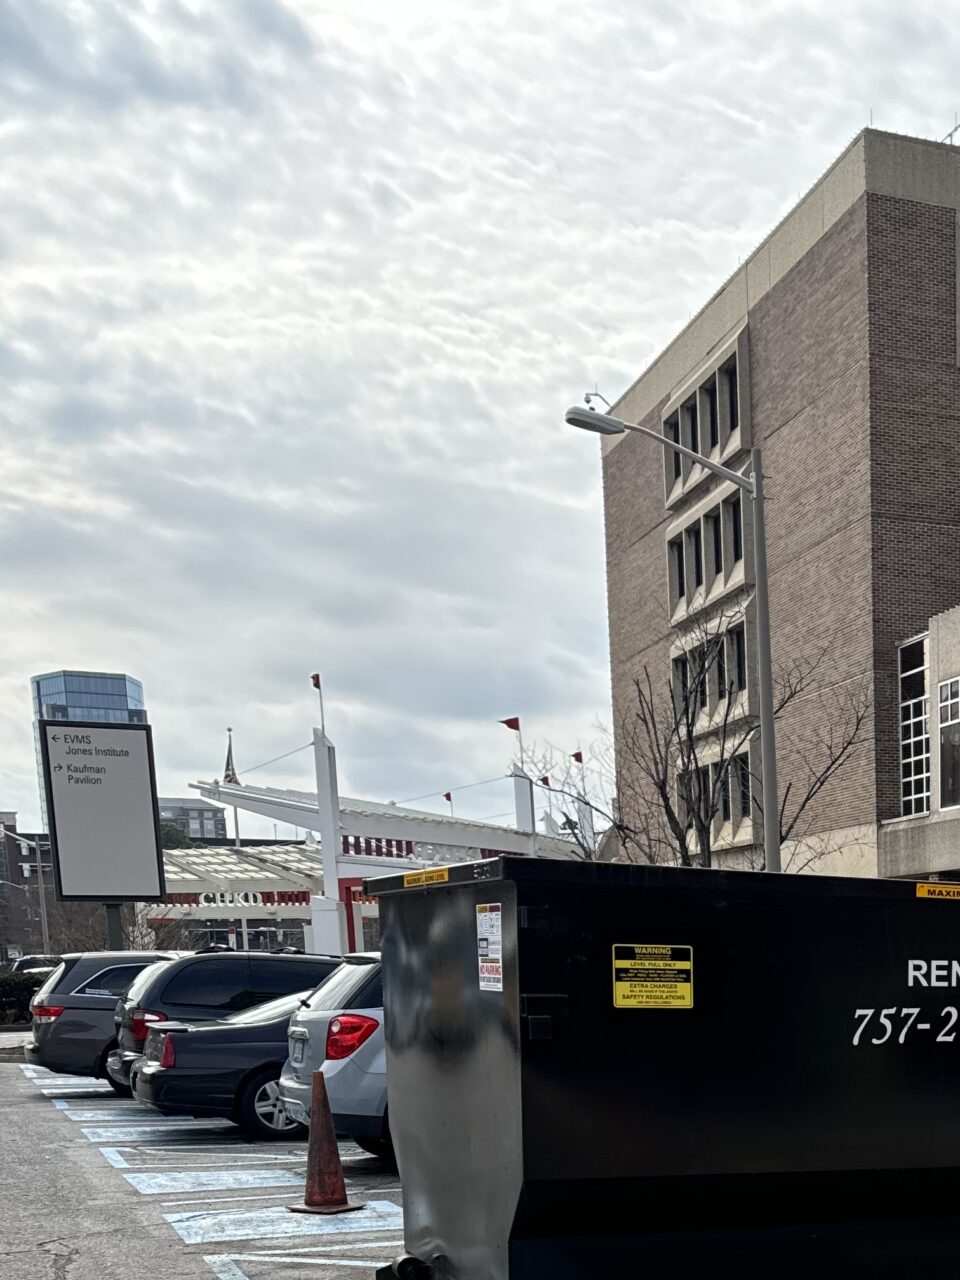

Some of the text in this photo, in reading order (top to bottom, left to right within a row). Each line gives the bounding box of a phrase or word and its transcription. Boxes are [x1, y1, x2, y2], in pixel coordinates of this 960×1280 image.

[64, 734, 92, 745] EVMS
[65, 746, 130, 758] Jones Institute
[66, 764, 106, 775] Kaufman
[67, 775, 103, 785] Pavilion
[199, 892, 263, 907] CHKD
